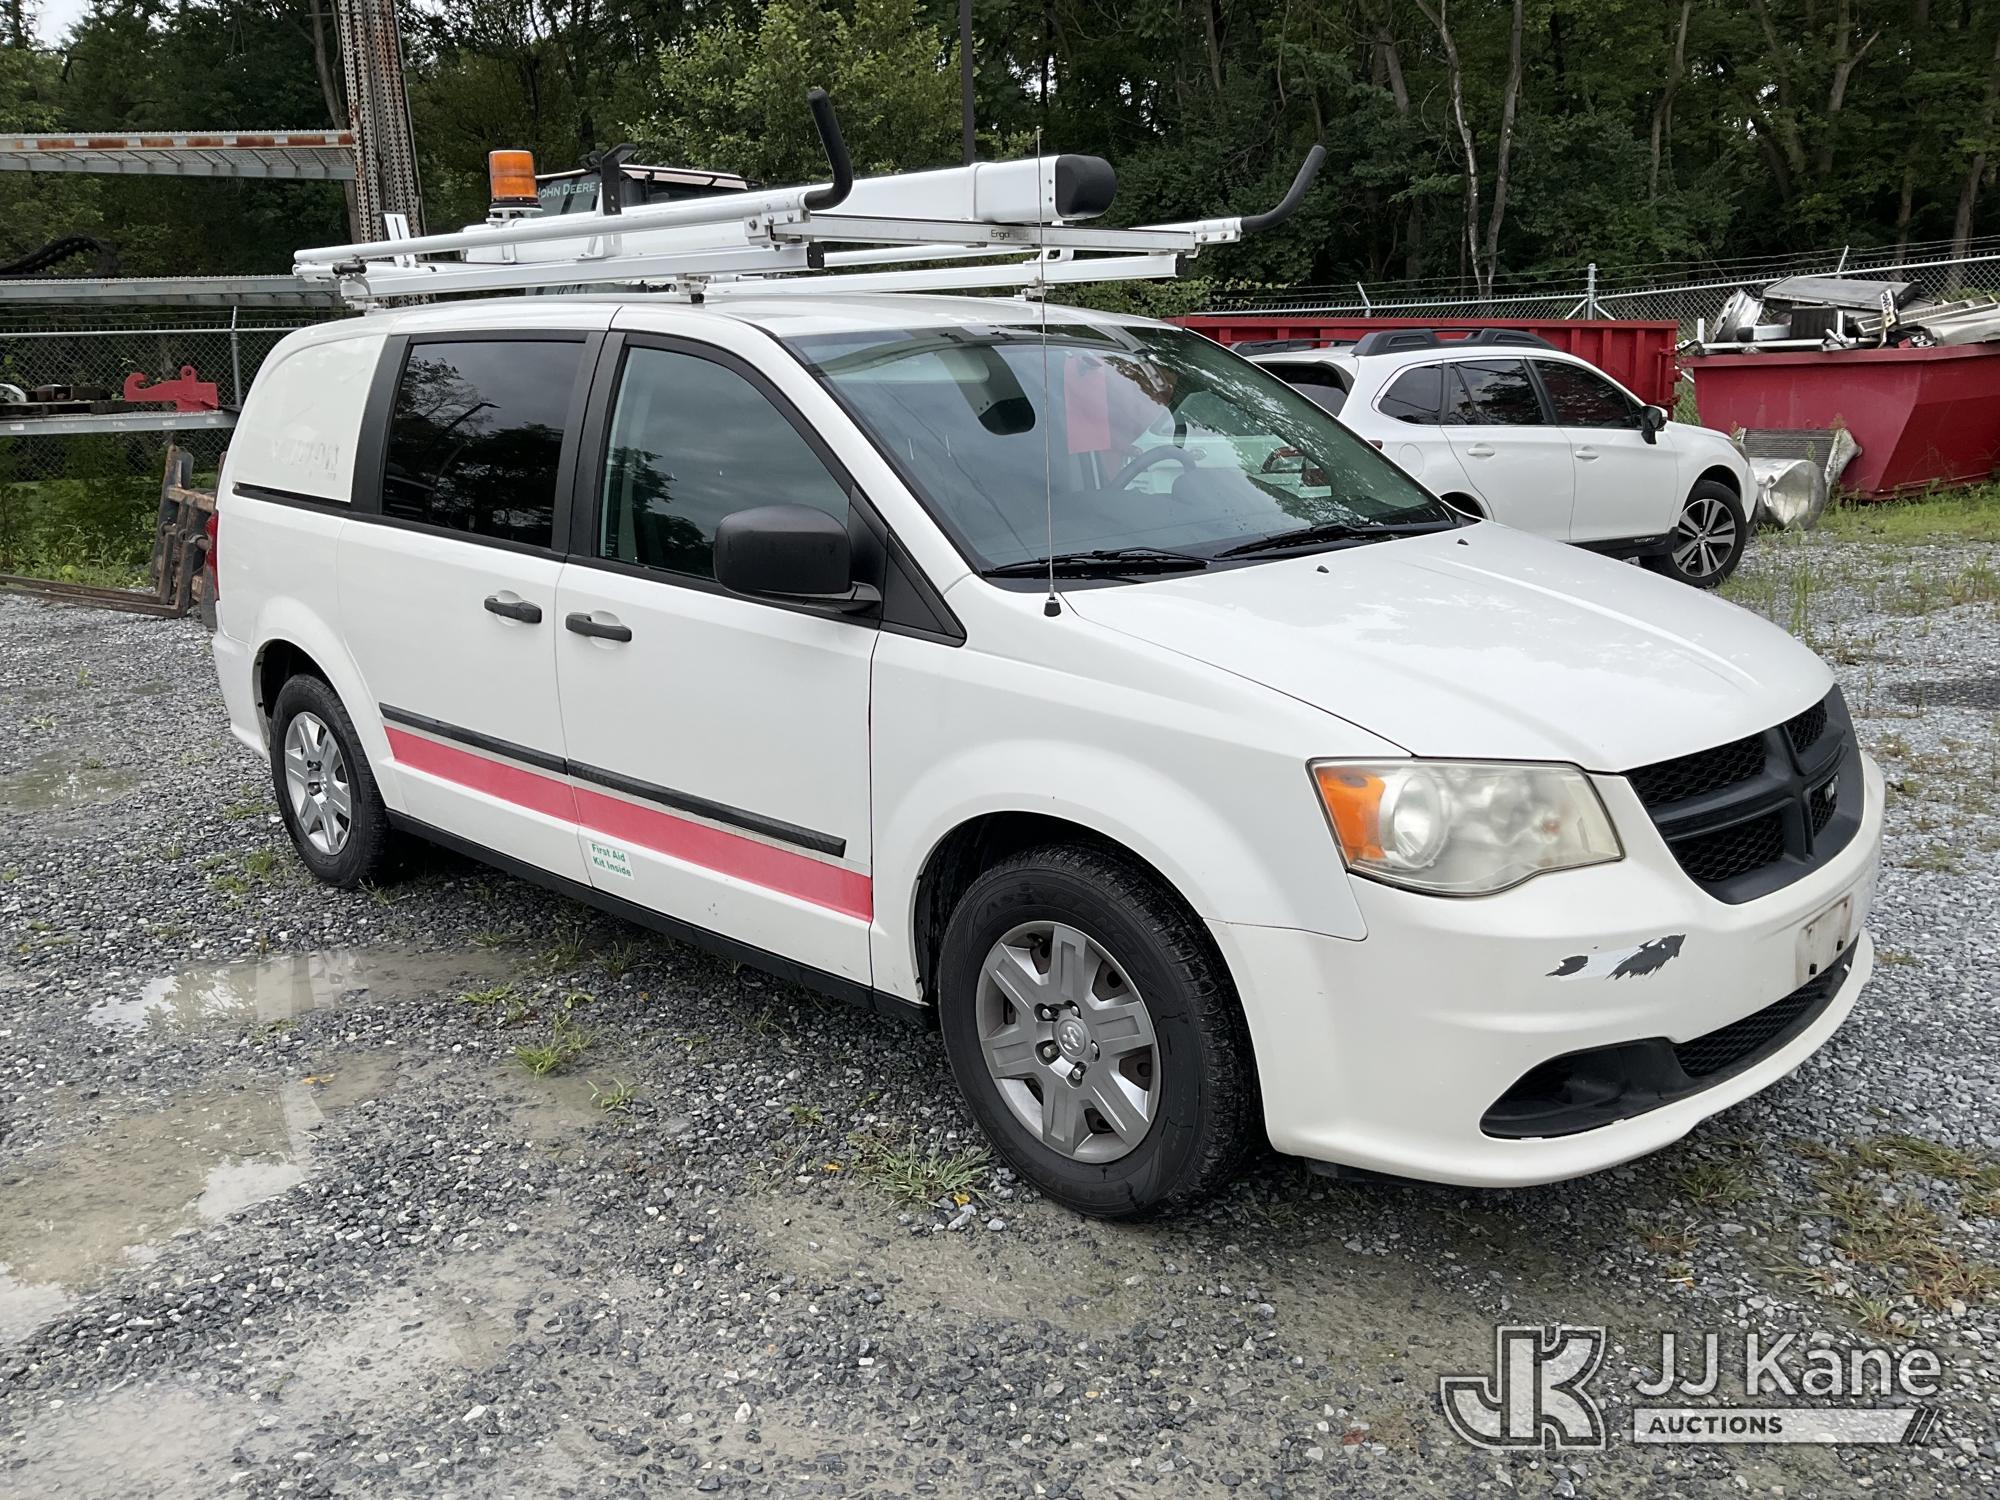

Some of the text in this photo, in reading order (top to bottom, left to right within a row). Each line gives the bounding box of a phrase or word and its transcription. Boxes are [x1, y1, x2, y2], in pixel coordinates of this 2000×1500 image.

[562, 182, 597, 196] DEERE
[592, 843, 626, 863] First Aid
[592, 856, 631, 877] Kit Inside
